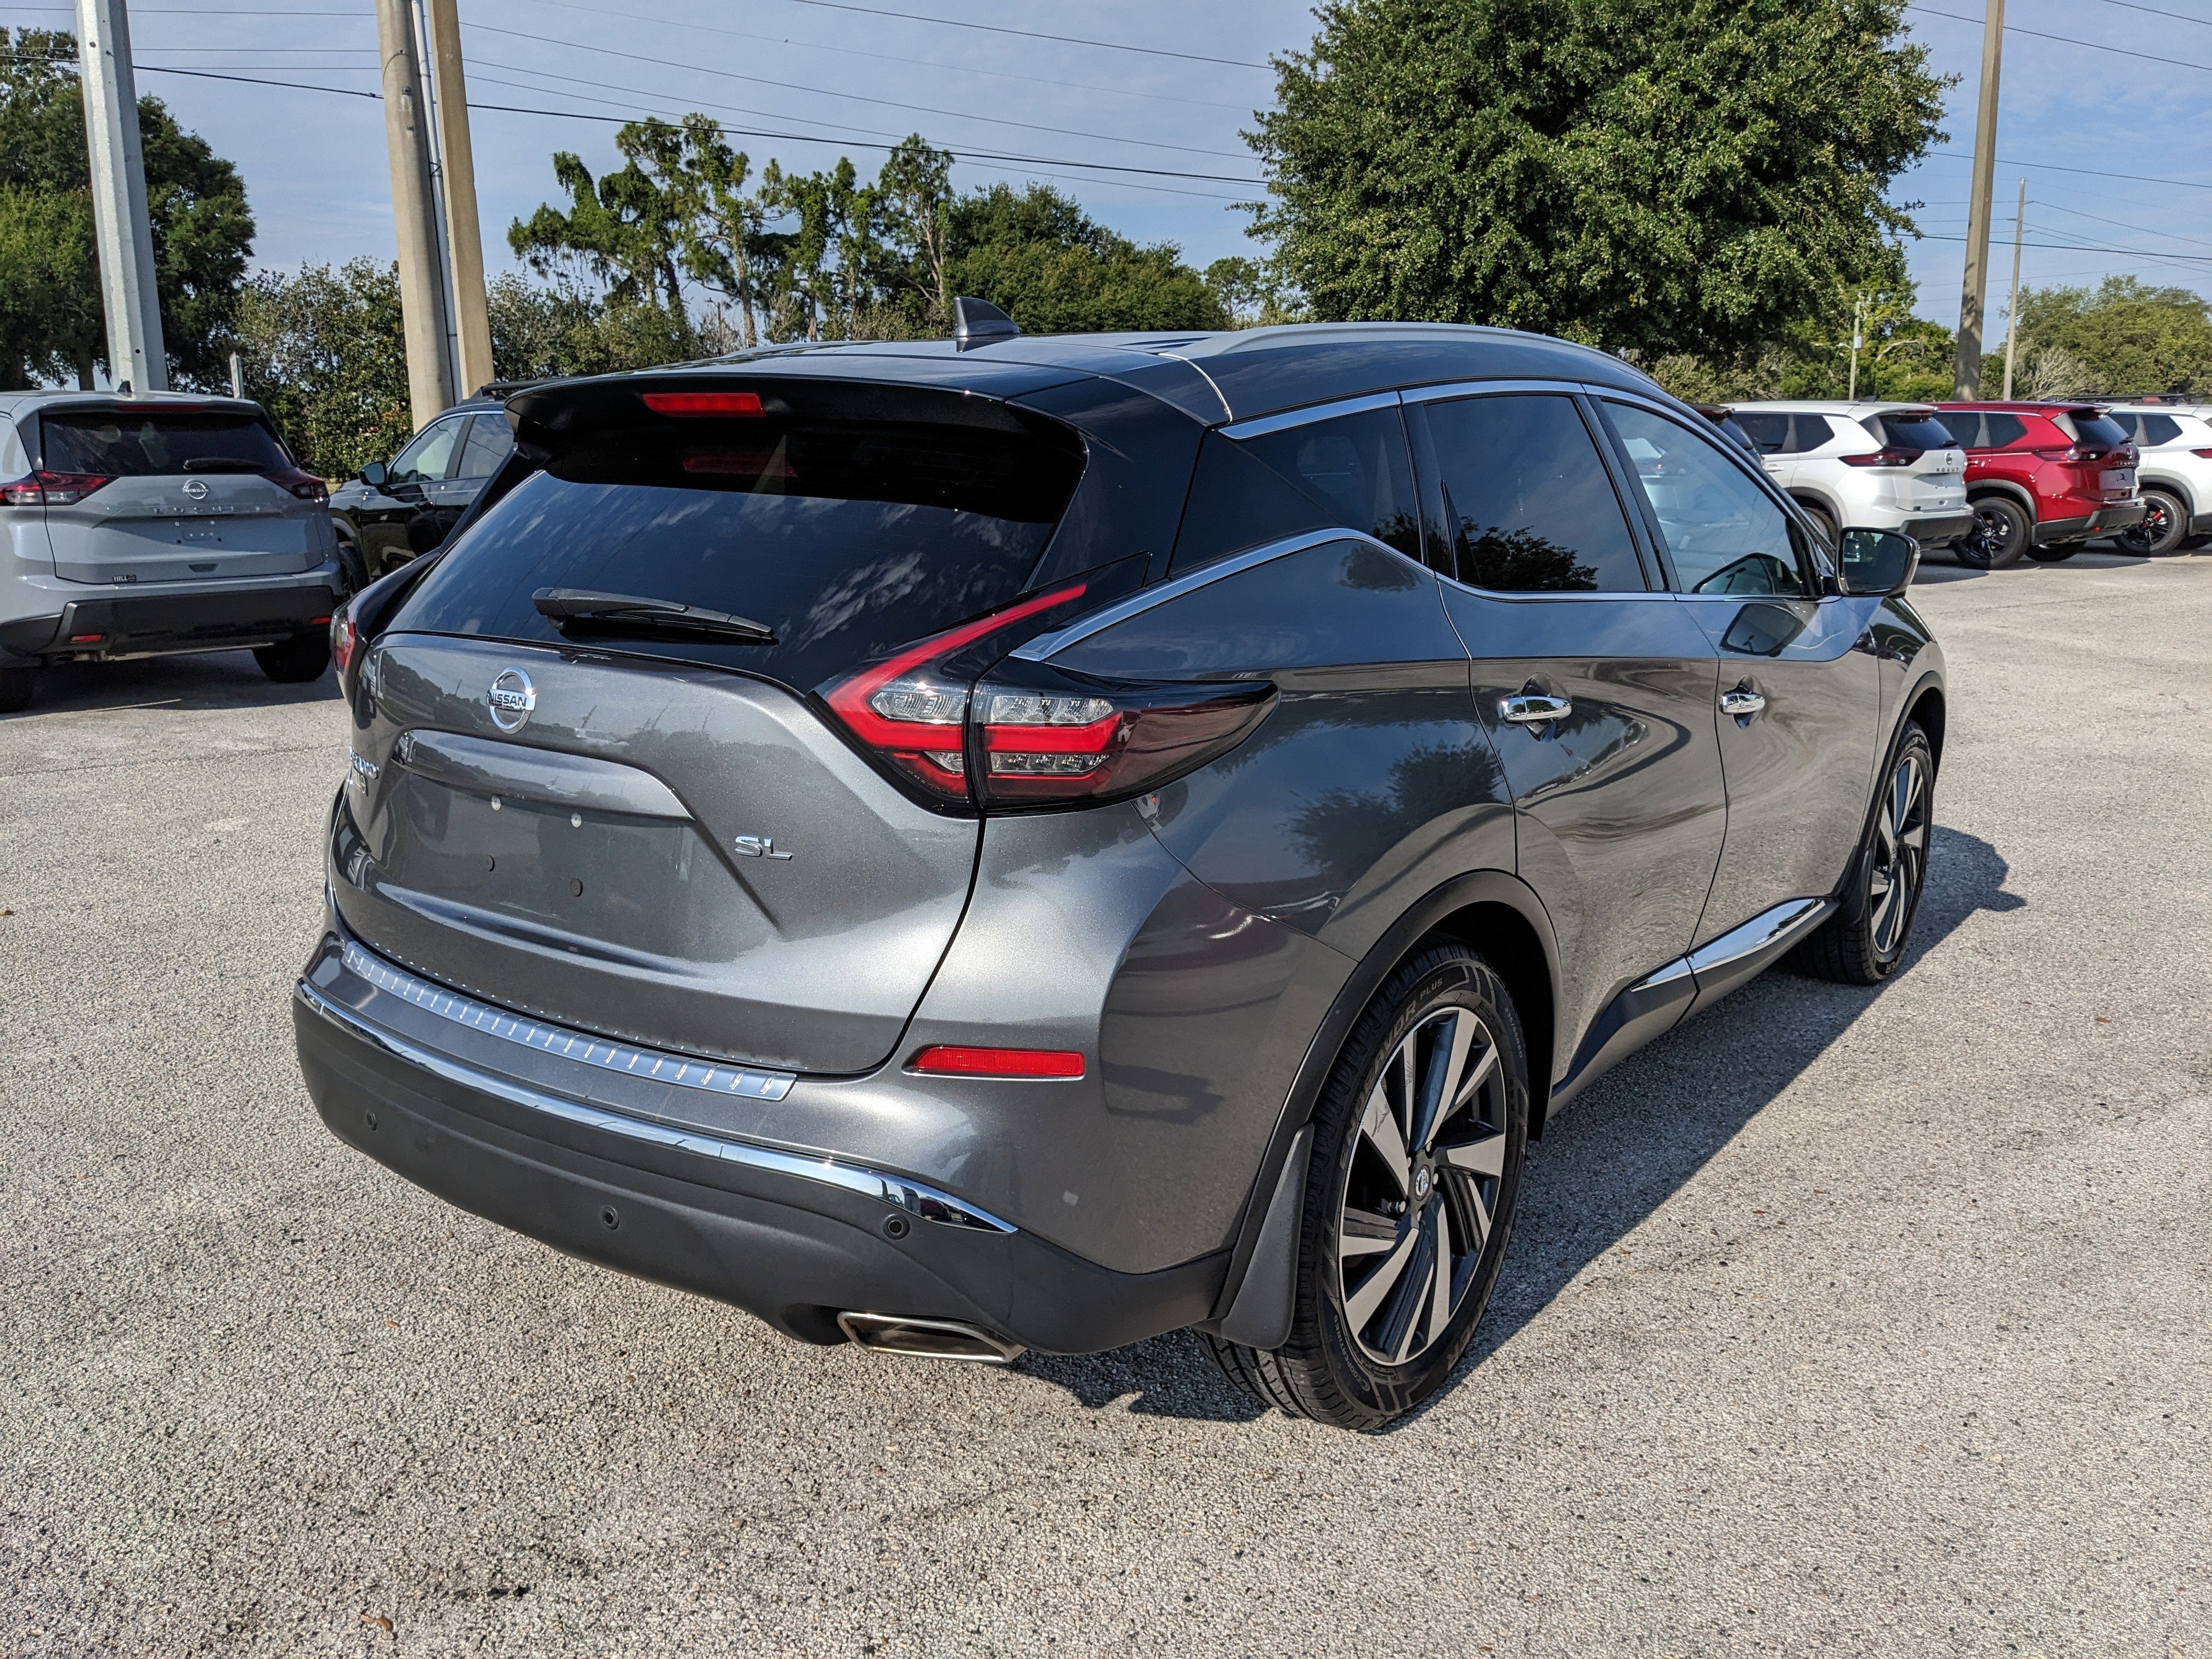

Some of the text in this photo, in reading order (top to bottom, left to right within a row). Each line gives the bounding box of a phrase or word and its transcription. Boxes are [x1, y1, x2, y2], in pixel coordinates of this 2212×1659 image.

[488, 692, 527, 708] NISSAN
[735, 836, 792, 860] SL
[1340, 978, 1443, 1170] ENDEAVOR PLUS
